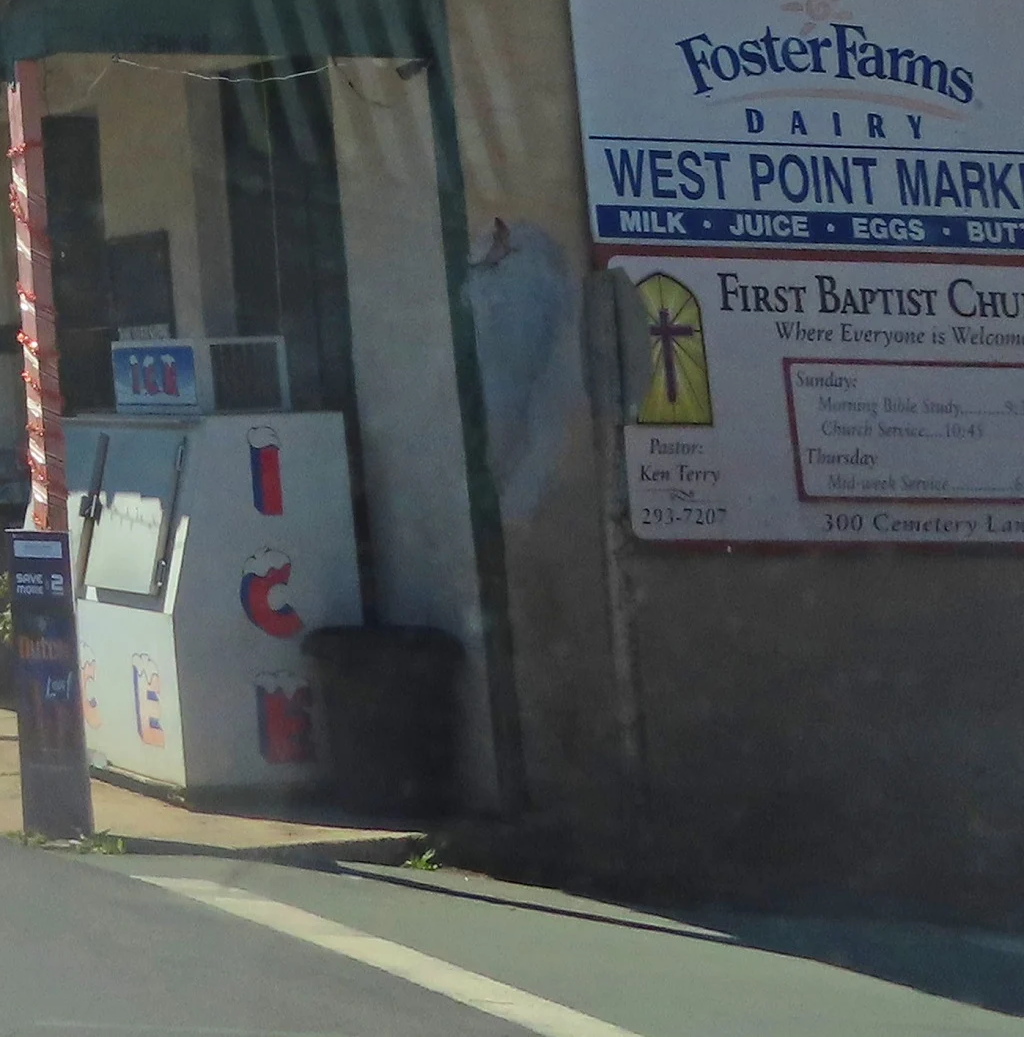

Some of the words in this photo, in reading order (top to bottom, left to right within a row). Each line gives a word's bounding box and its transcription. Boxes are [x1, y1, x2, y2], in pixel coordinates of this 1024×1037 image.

[746, 108, 923, 140] DAIRY
[605, 148, 731, 202] WEST
[750, 154, 877, 206] POINT
[895, 158, 1024, 211] MARK
[619, 211, 686, 234] MILK
[730, 214, 810, 238] JUICE
[853, 217, 925, 241] EGGS
[717, 272, 807, 313] FIRST
[815, 274, 938, 317] BAPTIST
[948, 278, 1024, 318] CHU
[776, 321, 833, 343] Where
[841, 323, 926, 348] Everyone
[932, 325, 946, 344] is
[795, 370, 858, 390] Sunday:
[817, 397, 878, 417] Morning
[883, 398, 918, 413] Bible
[821, 420, 873, 437] Church
[649, 438, 704, 455] Pastor:
[639, 465, 674, 482] Ken
[676, 465, 720, 485] Terry
[641, 507, 727, 526] 293-7207
[822, 513, 864, 532] 300
[873, 513, 977, 538] Cemetery
[16, 573, 43, 584] SAVE
[51, 573, 64, 591] 2
[16, 585, 44, 595] MORE
